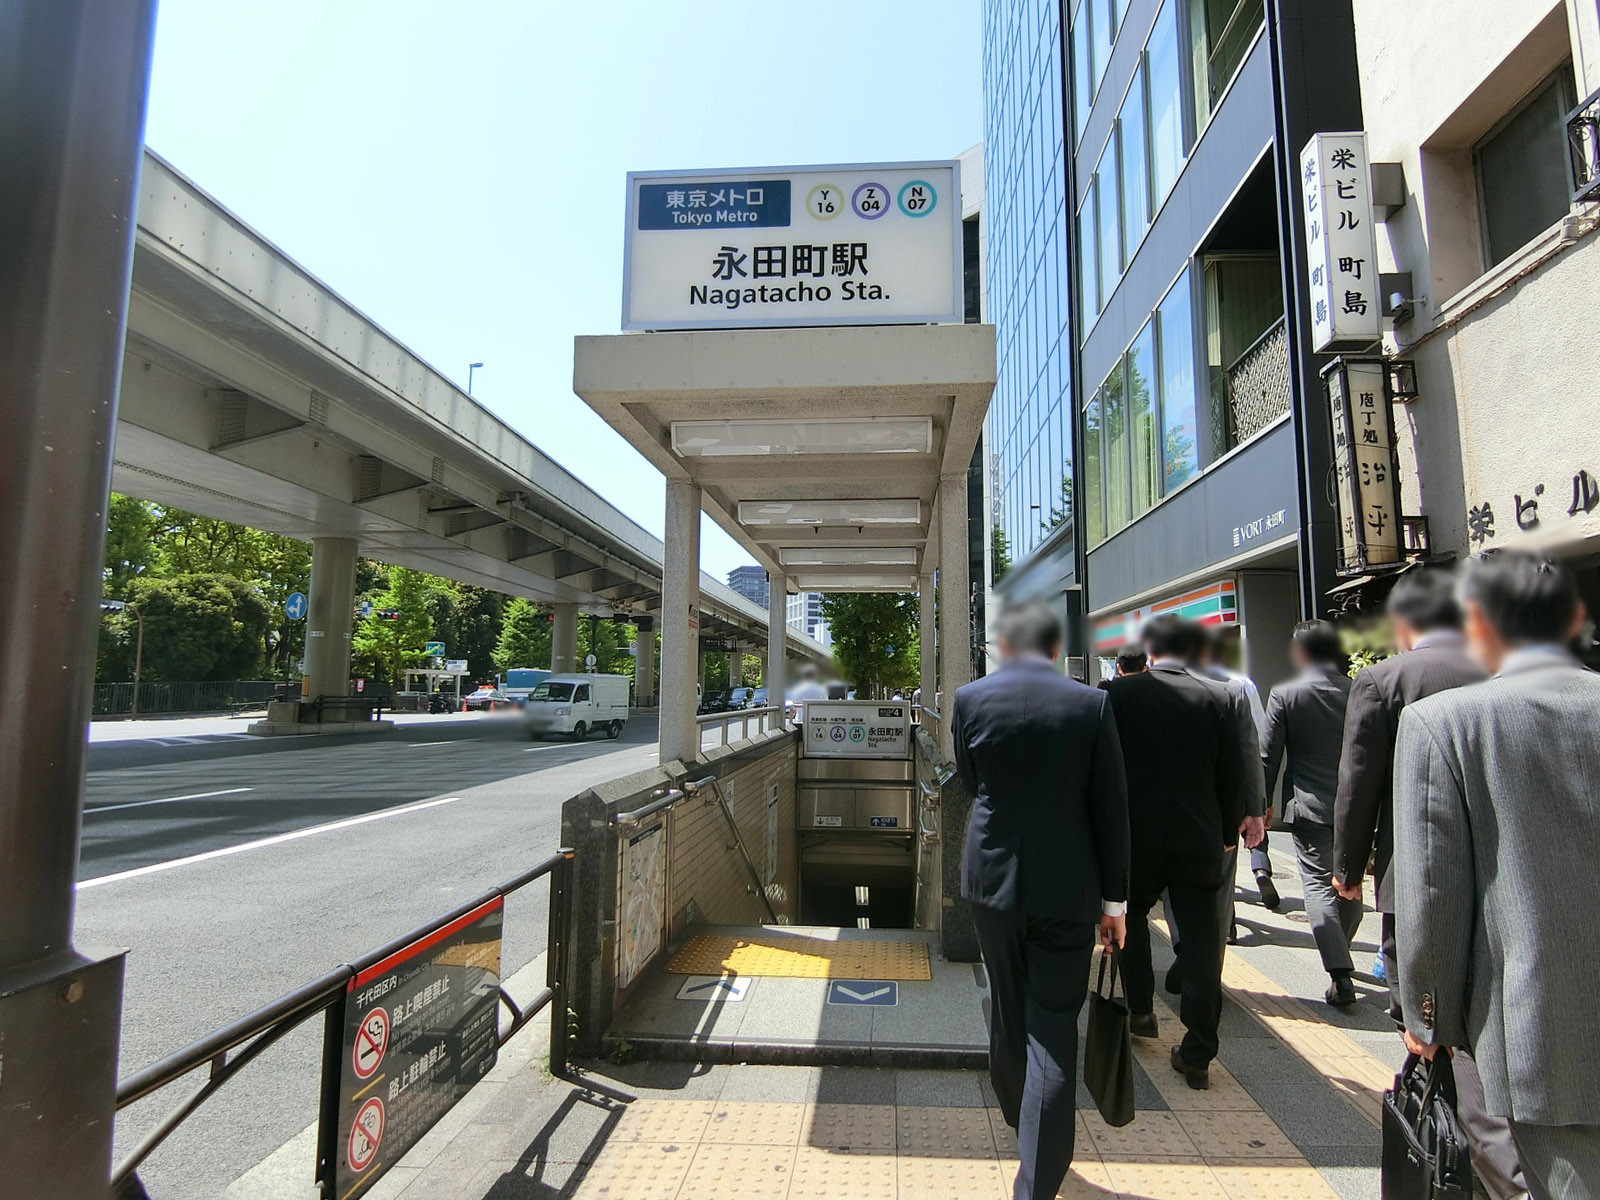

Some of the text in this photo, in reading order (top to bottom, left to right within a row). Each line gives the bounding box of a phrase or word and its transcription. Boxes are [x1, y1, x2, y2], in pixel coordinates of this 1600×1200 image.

[666, 188, 764, 209] 東京メトロ
[820, 190, 830, 200] Y
[866, 188, 876, 199] Z
[911, 187, 923, 198] N
[817, 202, 834, 214] 16
[861, 200, 880, 212] 04
[908, 198, 927, 210] 07
[672, 210, 758, 226] Tokyo Metro
[1331, 148, 1368, 316] 栄ビル 町島
[1304, 158, 1327, 326] 栄ビル 町島
[712, 242, 869, 280] 永田町駅
[690, 280, 890, 309] Nagatacho Sta.
[1469, 470, 1600, 544] 栄ビル
[1240, 518, 1263, 541] VORT
[868, 728, 903, 736] 永田町駅
[356, 974, 398, 1009] 千代田区内
